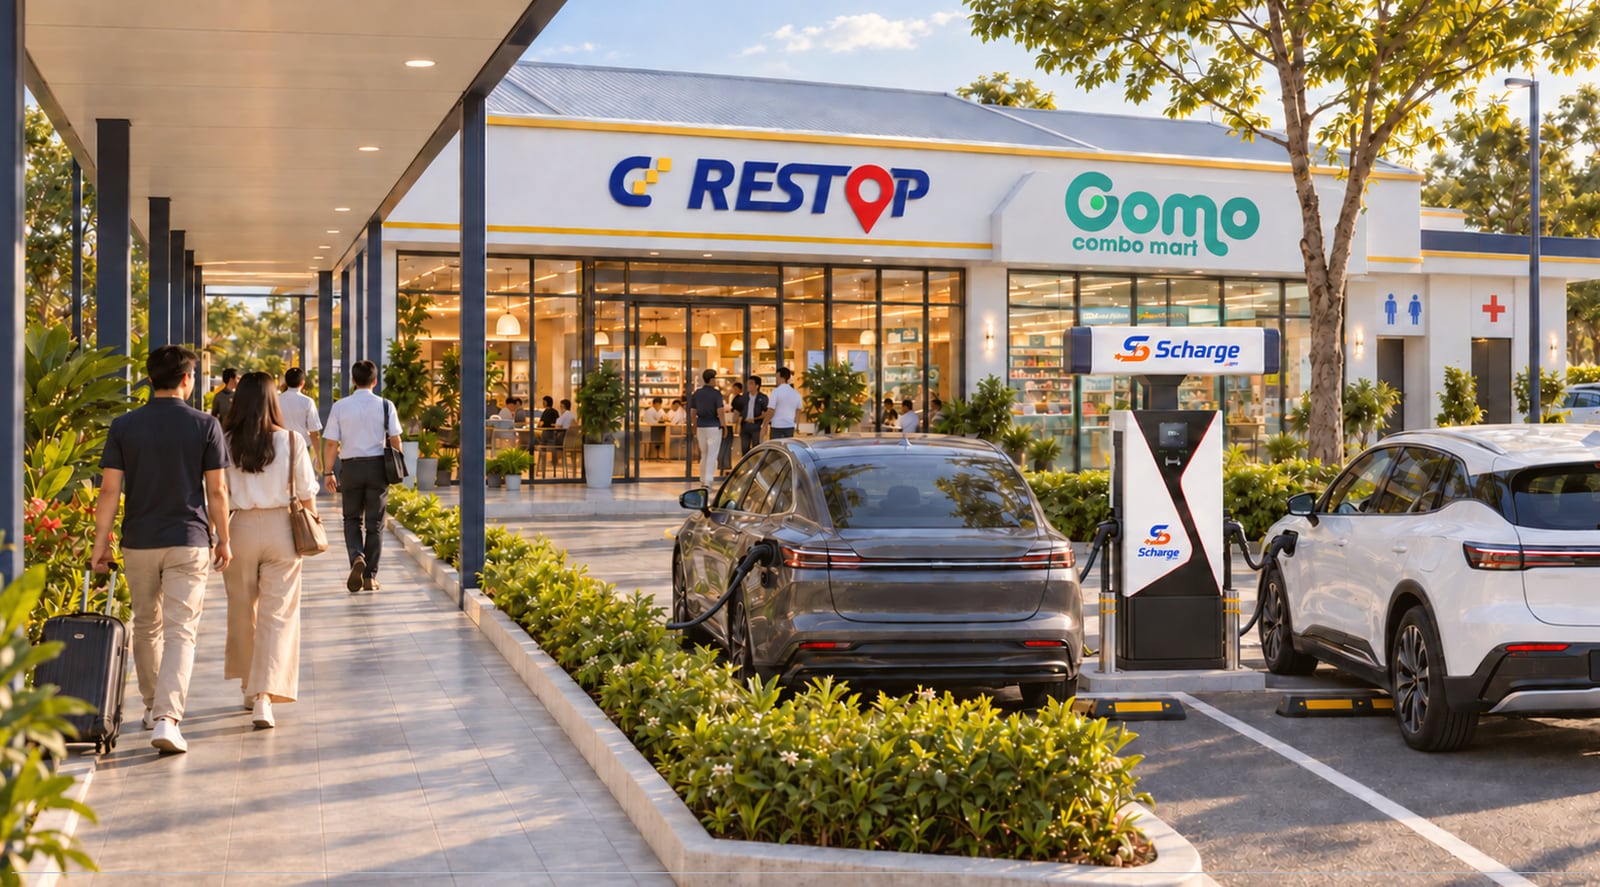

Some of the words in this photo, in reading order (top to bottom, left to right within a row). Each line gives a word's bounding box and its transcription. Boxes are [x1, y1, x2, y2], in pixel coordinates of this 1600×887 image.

[687, 158, 931, 234] RESTOP
[1065, 171, 1260, 257] Gomo
[1072, 236, 1144, 253] combo
[1150, 240, 1198, 257] mart
[1154, 340, 1240, 364] Scharge
[1137, 547, 1180, 560] Scharge
